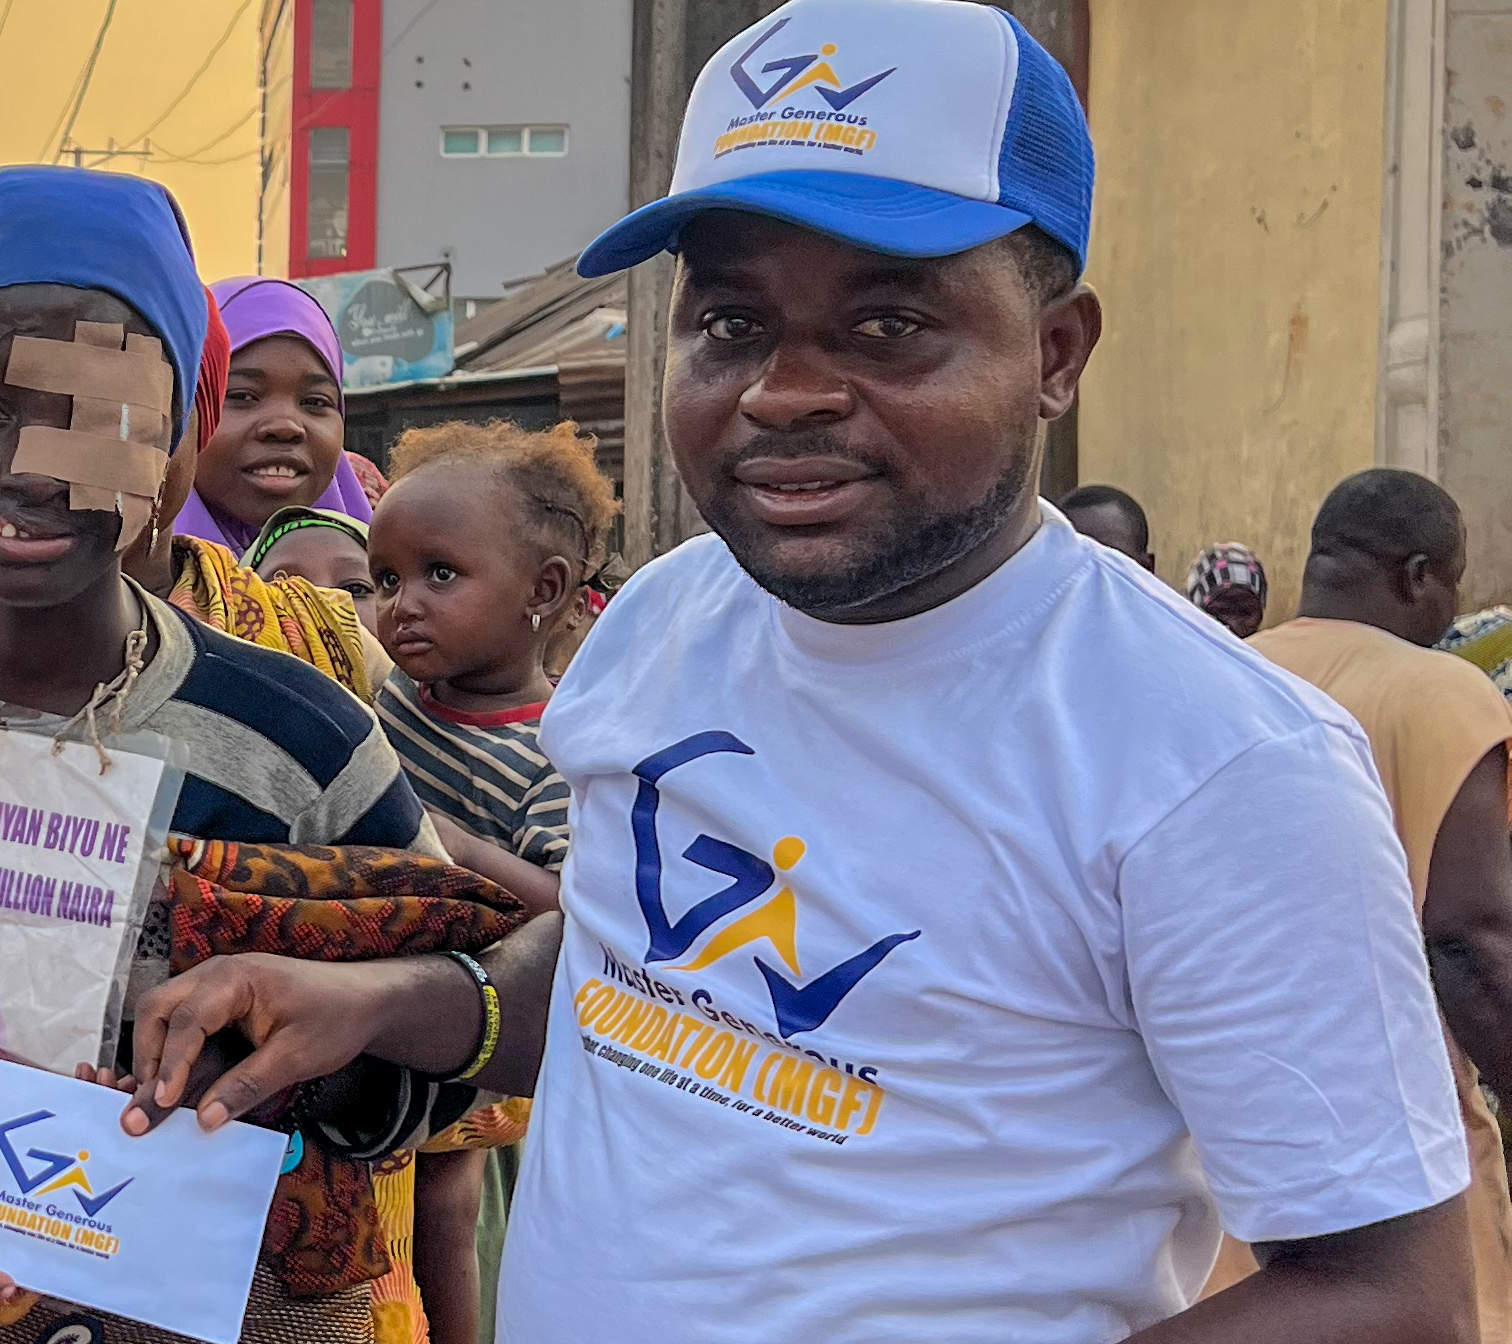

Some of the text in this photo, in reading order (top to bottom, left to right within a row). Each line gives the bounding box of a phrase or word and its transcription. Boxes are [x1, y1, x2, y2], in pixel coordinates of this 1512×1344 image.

[727, 106, 868, 132] Master Generous
[815, 122, 878, 150] (MGF)
[43, 811, 100, 858] BIYU
[98, 822, 131, 864] NE
[56, 880, 116, 929] NAIRA
[599, 940, 685, 1006] Master
[573, 978, 760, 1094] FOUNDATION
[752, 1051, 885, 1137] (MGF)
[597, 1045, 643, 1072] changing
[639, 1062, 661, 1079] one
[657, 1067, 679, 1086] life
[676, 1075, 693, 1092] at
[689, 1082, 701, 1094] a
[699, 1086, 731, 1107] time,
[731, 1099, 755, 1113] for
[751, 1108, 764, 1117] a
[763, 1110, 808, 1132] better
[806, 1127, 849, 1146] world
[46, 1203, 113, 1234] Generous
[74, 1227, 121, 1255] (MGF)
